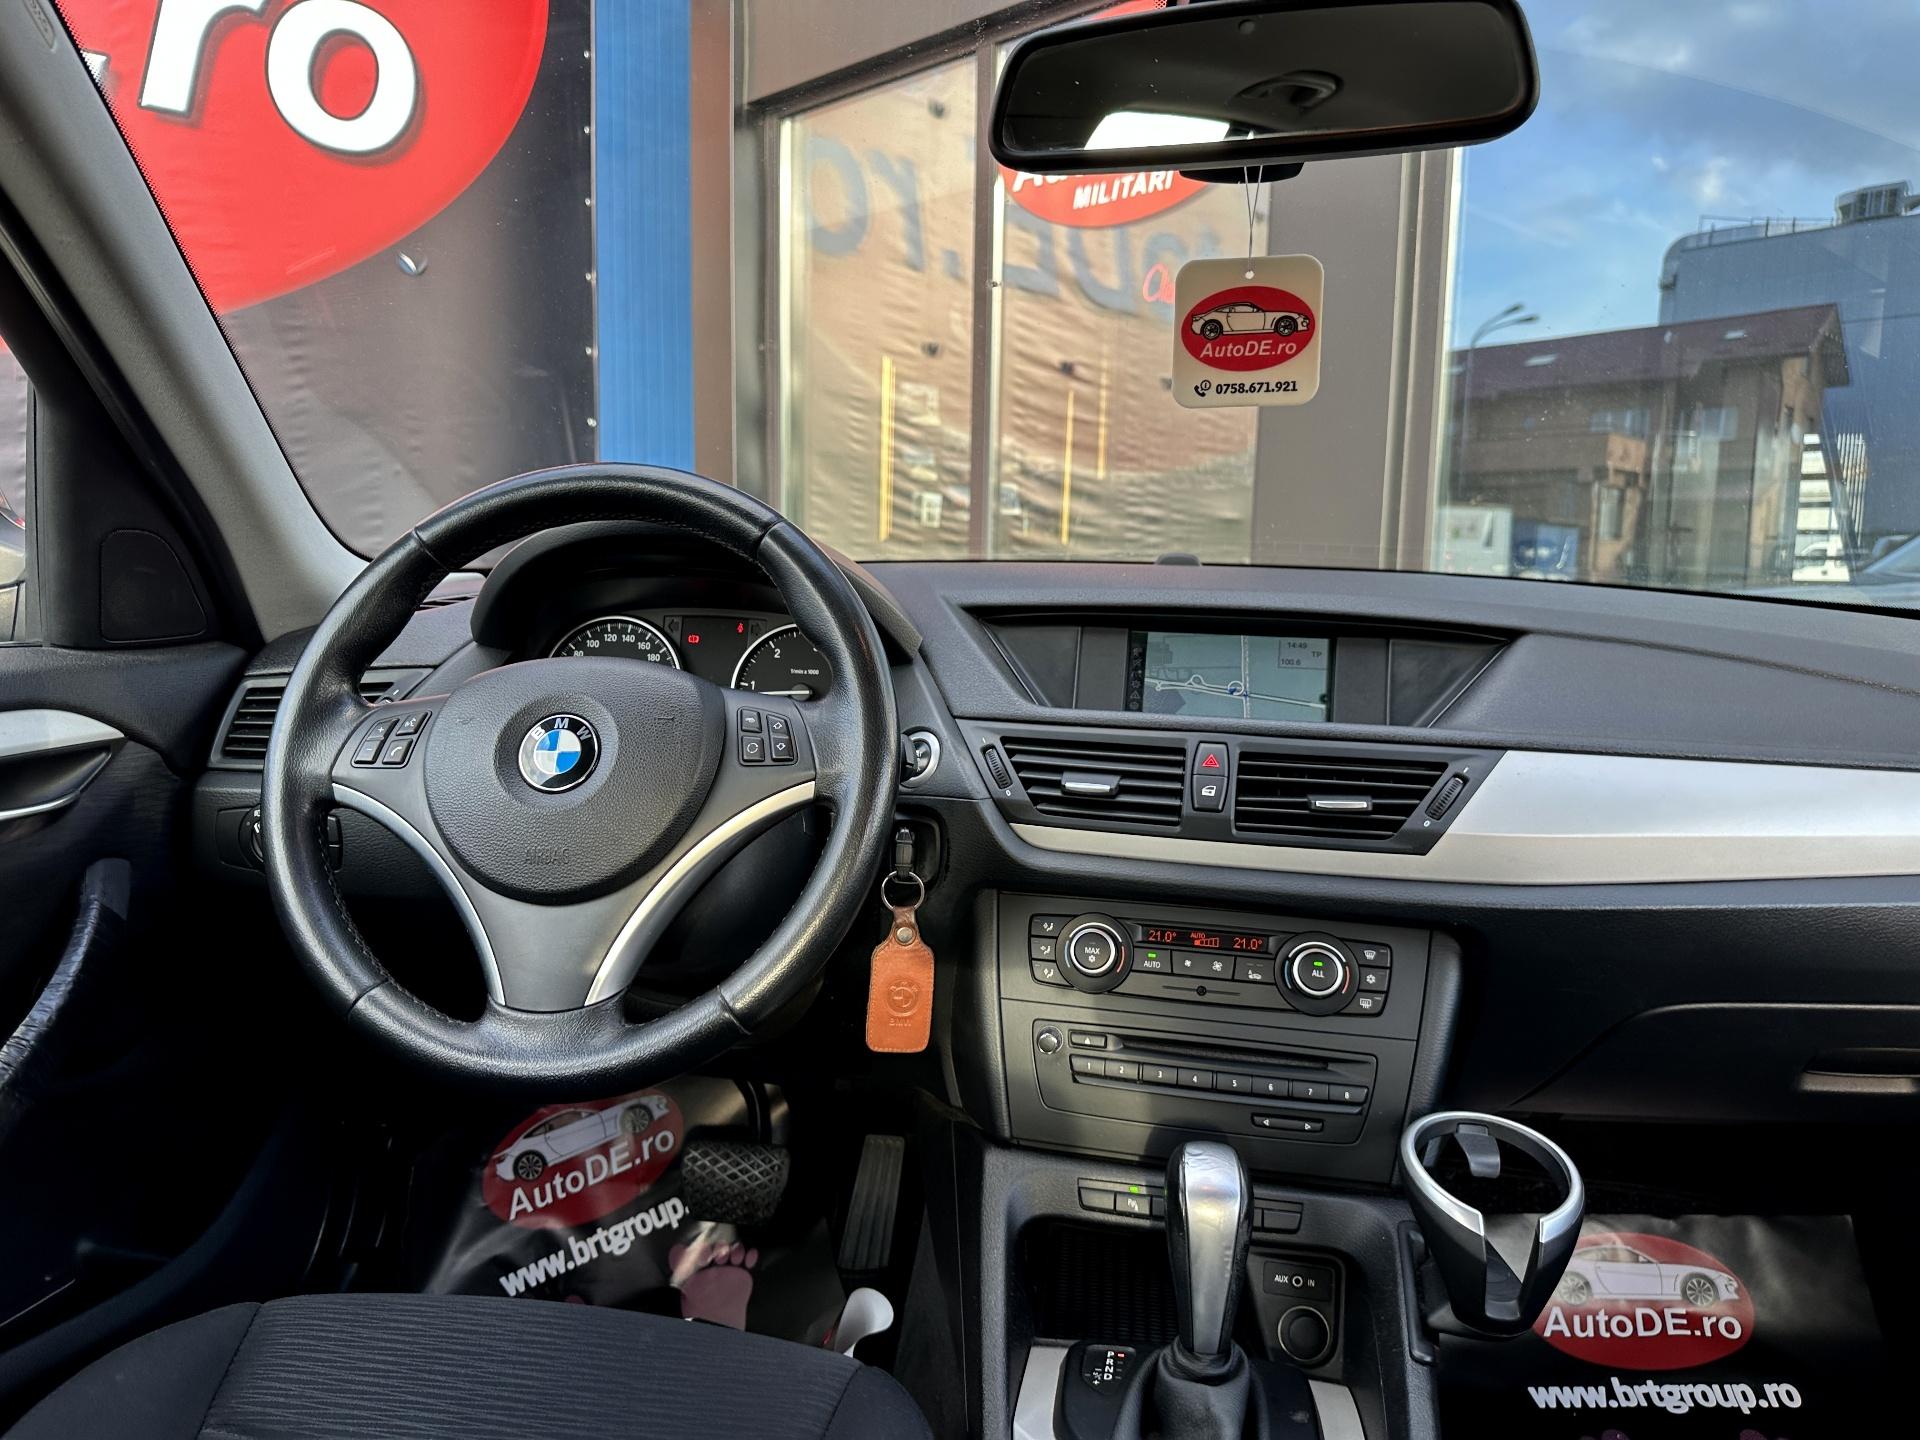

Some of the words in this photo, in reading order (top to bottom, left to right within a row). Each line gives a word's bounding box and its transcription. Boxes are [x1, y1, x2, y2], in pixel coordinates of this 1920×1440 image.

[1073, 171, 1174, 210] MILITARI
[1200, 340, 1297, 358] AutoDE.ro
[1215, 381, 1298, 395] 0758.671.921
[603, 633, 617, 642] 120
[621, 634, 635, 643] 140
[586, 640, 600, 648] 100
[637, 641, 651, 650] 160
[647, 653, 661, 662] 180
[773, 648, 781, 658] 2
[750, 680, 756, 690] 1
[531, 718, 592, 741] BMW
[1084, 946, 1100, 955] MAX
[1143, 960, 1161, 969] AUTO
[1311, 969, 1325, 978] ALL
[1119, 1065, 1124, 1074] 2
[1158, 1070, 1163, 1078] 3
[1192, 1075, 1198, 1083] 4
[1232, 1079, 1237, 1087] 5
[1268, 1083, 1273, 1091] 6
[1308, 1088, 1313, 1096] 7
[1344, 1091, 1350, 1099] 8
[508, 1129, 675, 1220] AutoDE.ro
[1274, 1274, 1288, 1284] AUX
[1307, 1278, 1315, 1287] IN
[1543, 1306, 1743, 1340] AutoDE.ro
[1107, 1350, 1115, 1358] P
[1106, 1358, 1114, 1366] R
[1104, 1365, 1114, 1373] N
[1103, 1372, 1113, 1380] D
[1527, 1377, 1802, 1415] www.brtgroup.ro
